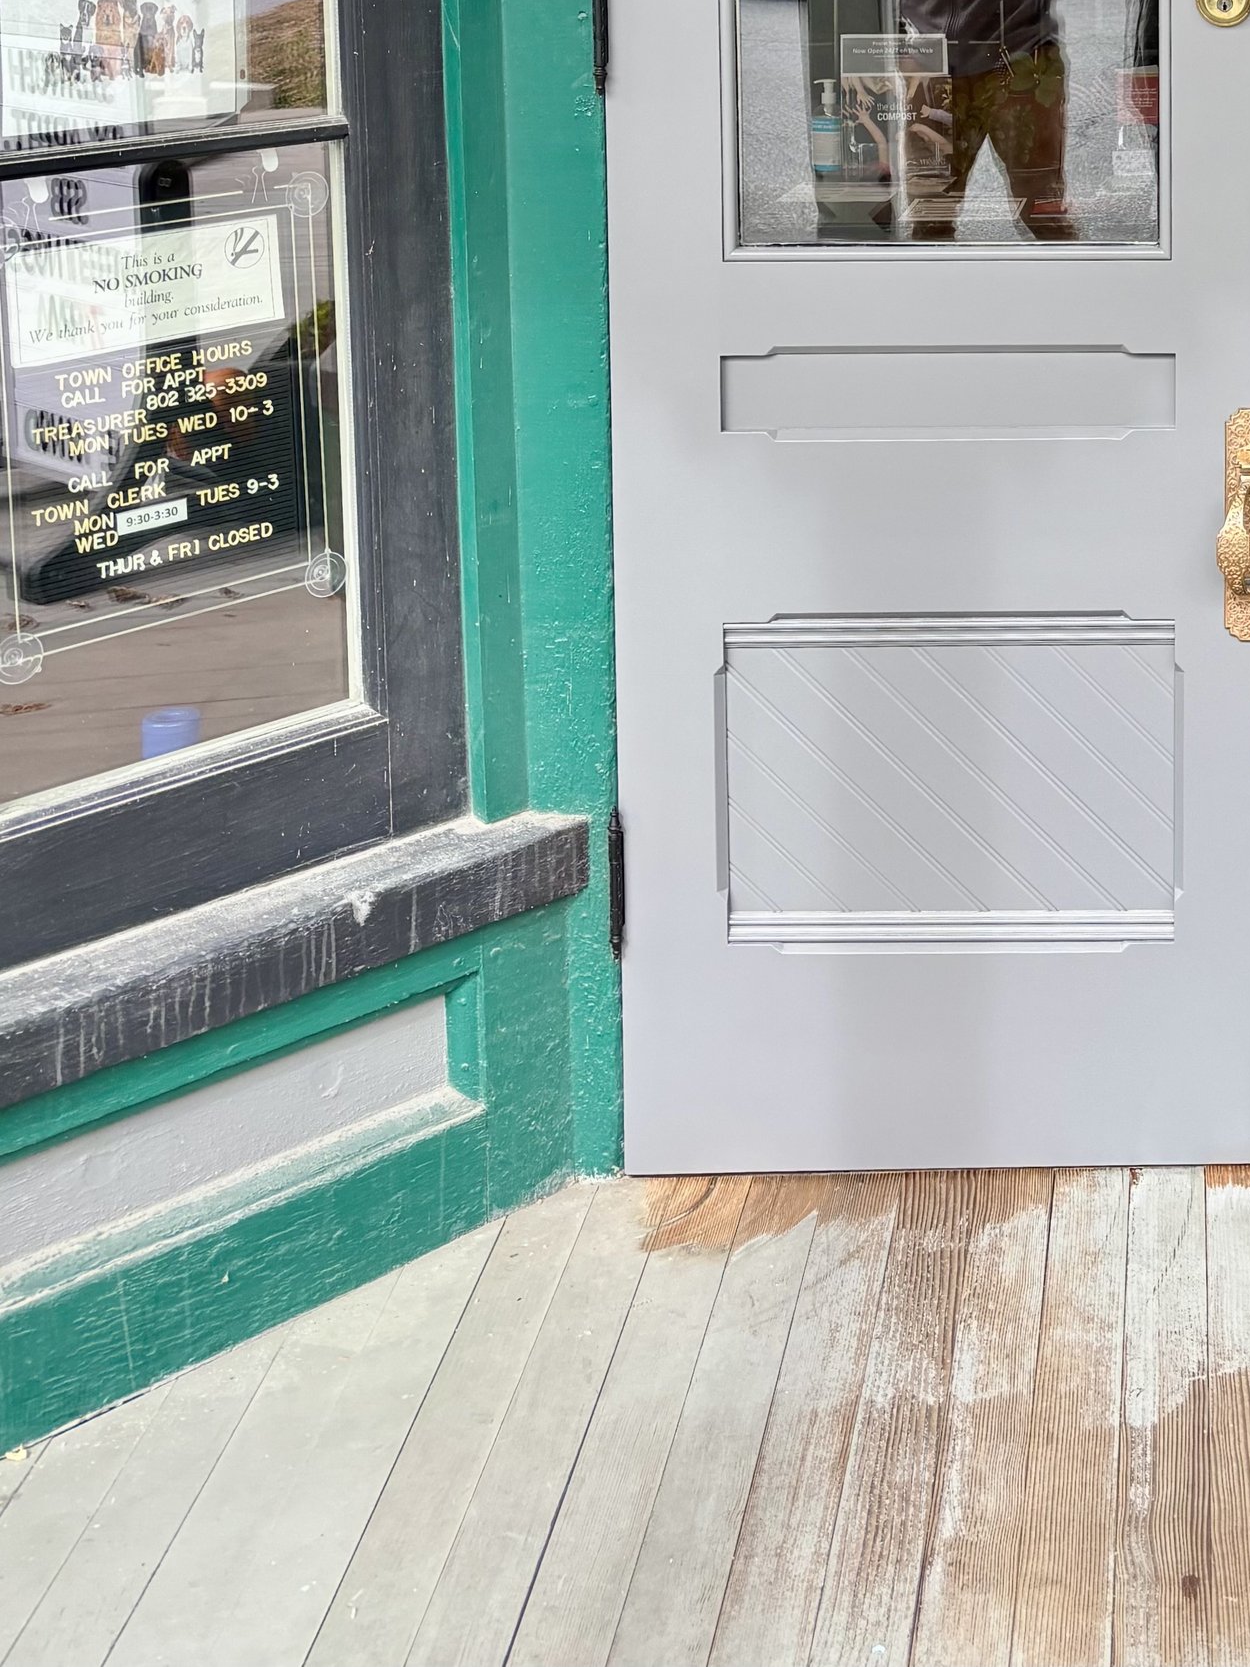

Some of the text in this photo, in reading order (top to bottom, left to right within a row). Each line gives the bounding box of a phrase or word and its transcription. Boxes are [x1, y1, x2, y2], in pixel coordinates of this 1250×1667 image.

[867, 47, 884, 55] Open
[876, 102, 889, 112] the
[877, 111, 918, 122] COMPOST
[92, 263, 204, 294] NO SMOKING
[121, 252, 176, 271] This is a
[28, 293, 264, 344] We thank you for your consideration.
[124, 290, 175, 309] building.
[55, 340, 253, 391] TOWN OFFICE HOURS
[61, 366, 207, 409] CALL FOR APPT
[146, 372, 269, 412] 802 325-3309
[31, 408, 148, 446] TREASURER
[68, 434, 110, 458] MON
[120, 422, 169, 446] TUES
[177, 411, 218, 433] WED
[67, 442, 232, 494] CALL FOR APPT
[31, 482, 167, 527] TOWN CLERK
[73, 473, 281, 536] MON 9:30-3:30 TUES 9-3
[74, 531, 119, 554] WED
[96, 521, 275, 580] THUR & FRI CLOSED
